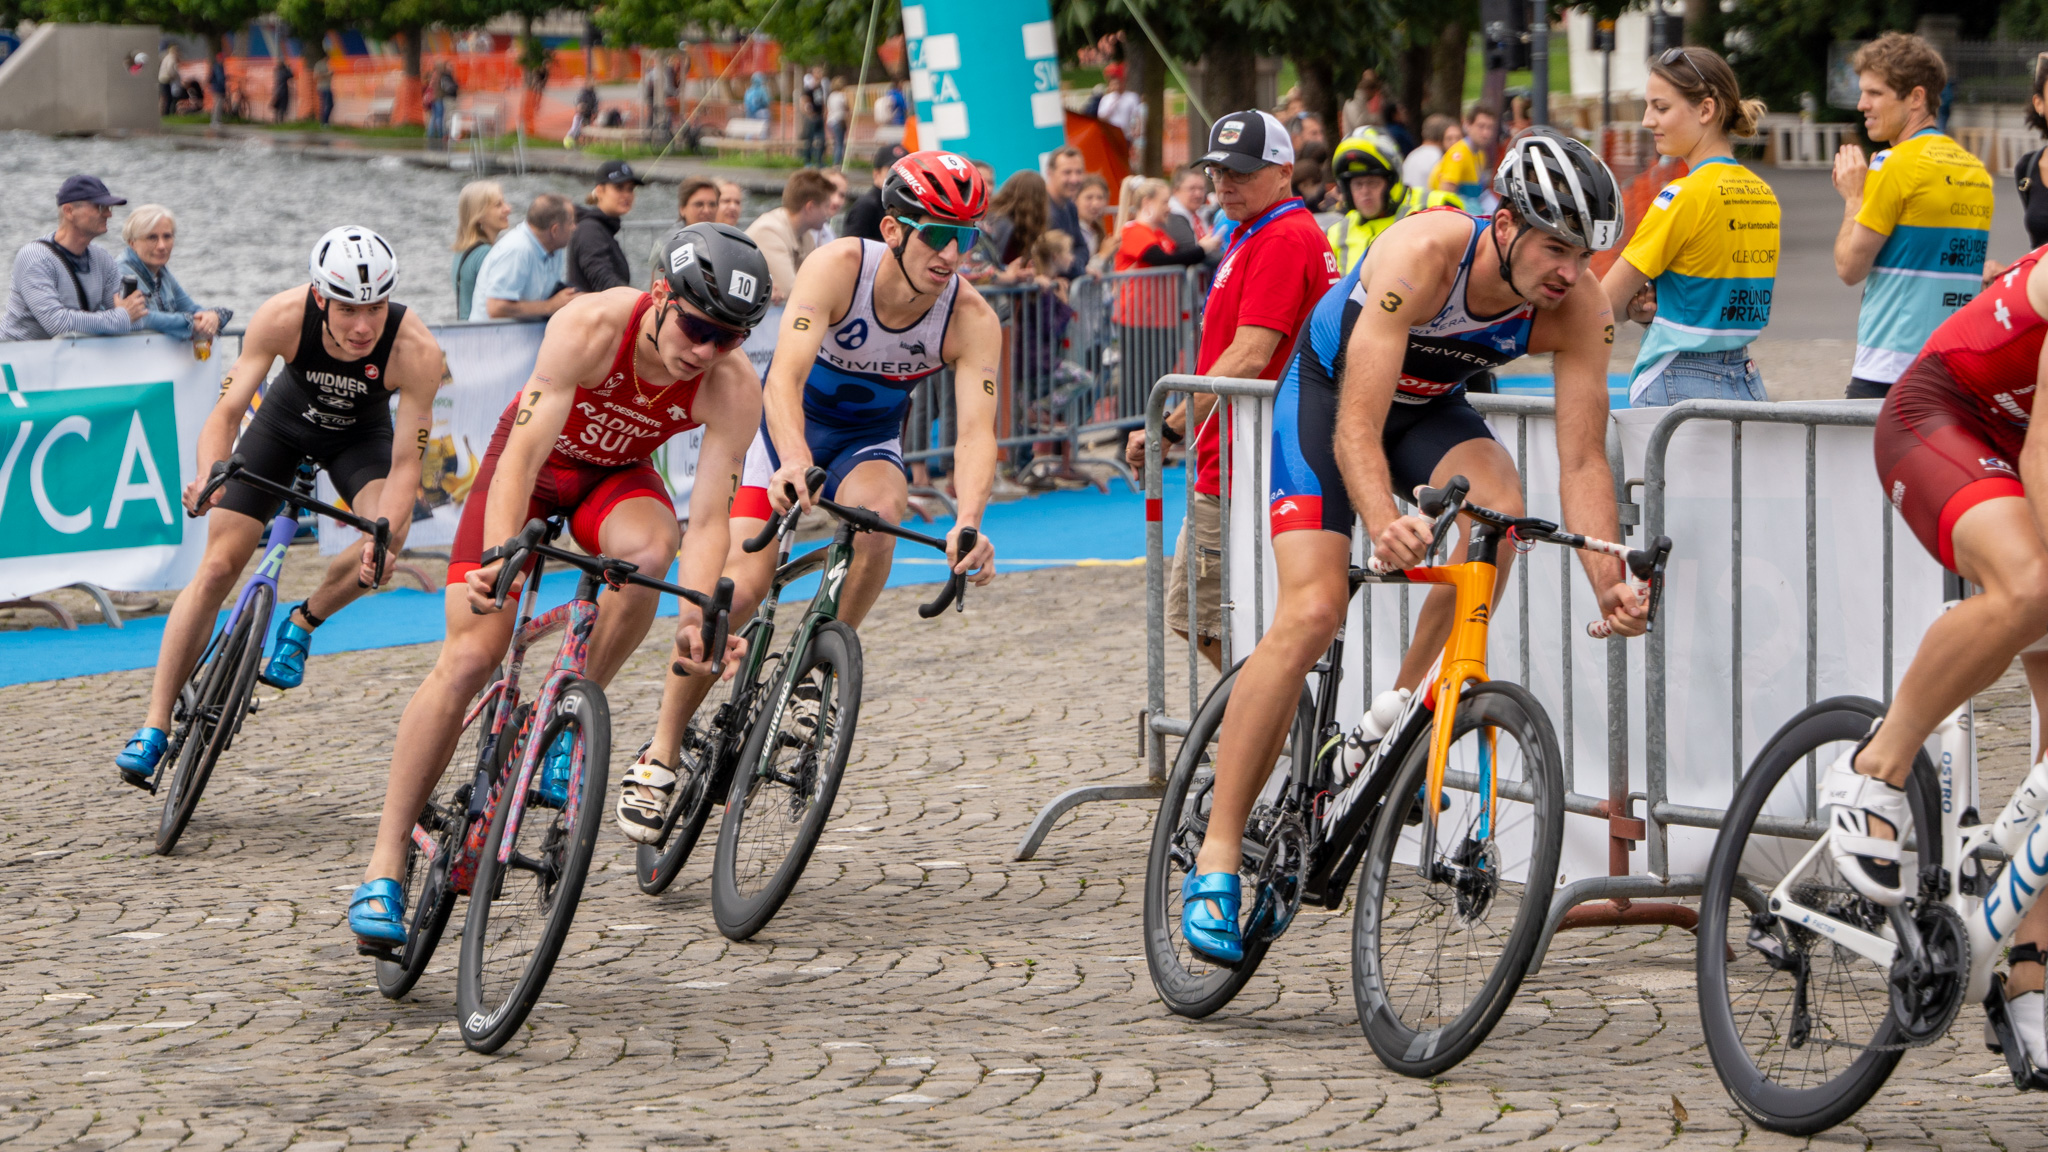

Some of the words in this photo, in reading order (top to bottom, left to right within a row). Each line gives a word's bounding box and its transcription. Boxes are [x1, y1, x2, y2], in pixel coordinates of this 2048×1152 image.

[1600, 225, 1608, 246] 3
[1748, 221, 1779, 230] Kantonalba
[673, 250, 690, 268] 10
[361, 287, 372, 301] 27
[738, 276, 752, 297] 10
[1380, 291, 1403, 313] 3
[792, 317, 811, 331] 6
[1409, 316, 1467, 335] RIVIERA
[1604, 325, 1614, 344] 3
[819, 345, 930, 374] TRIVIERA
[1410, 341, 1499, 368] TRIVIERA
[306, 370, 368, 395] WIDMER
[983, 380, 994, 395] 6
[576, 401, 661, 438] RADINA
[612, 404, 662, 428] DESCENTE
[580, 423, 633, 453] SUI
[1942, 751, 1953, 814] OSTRO
